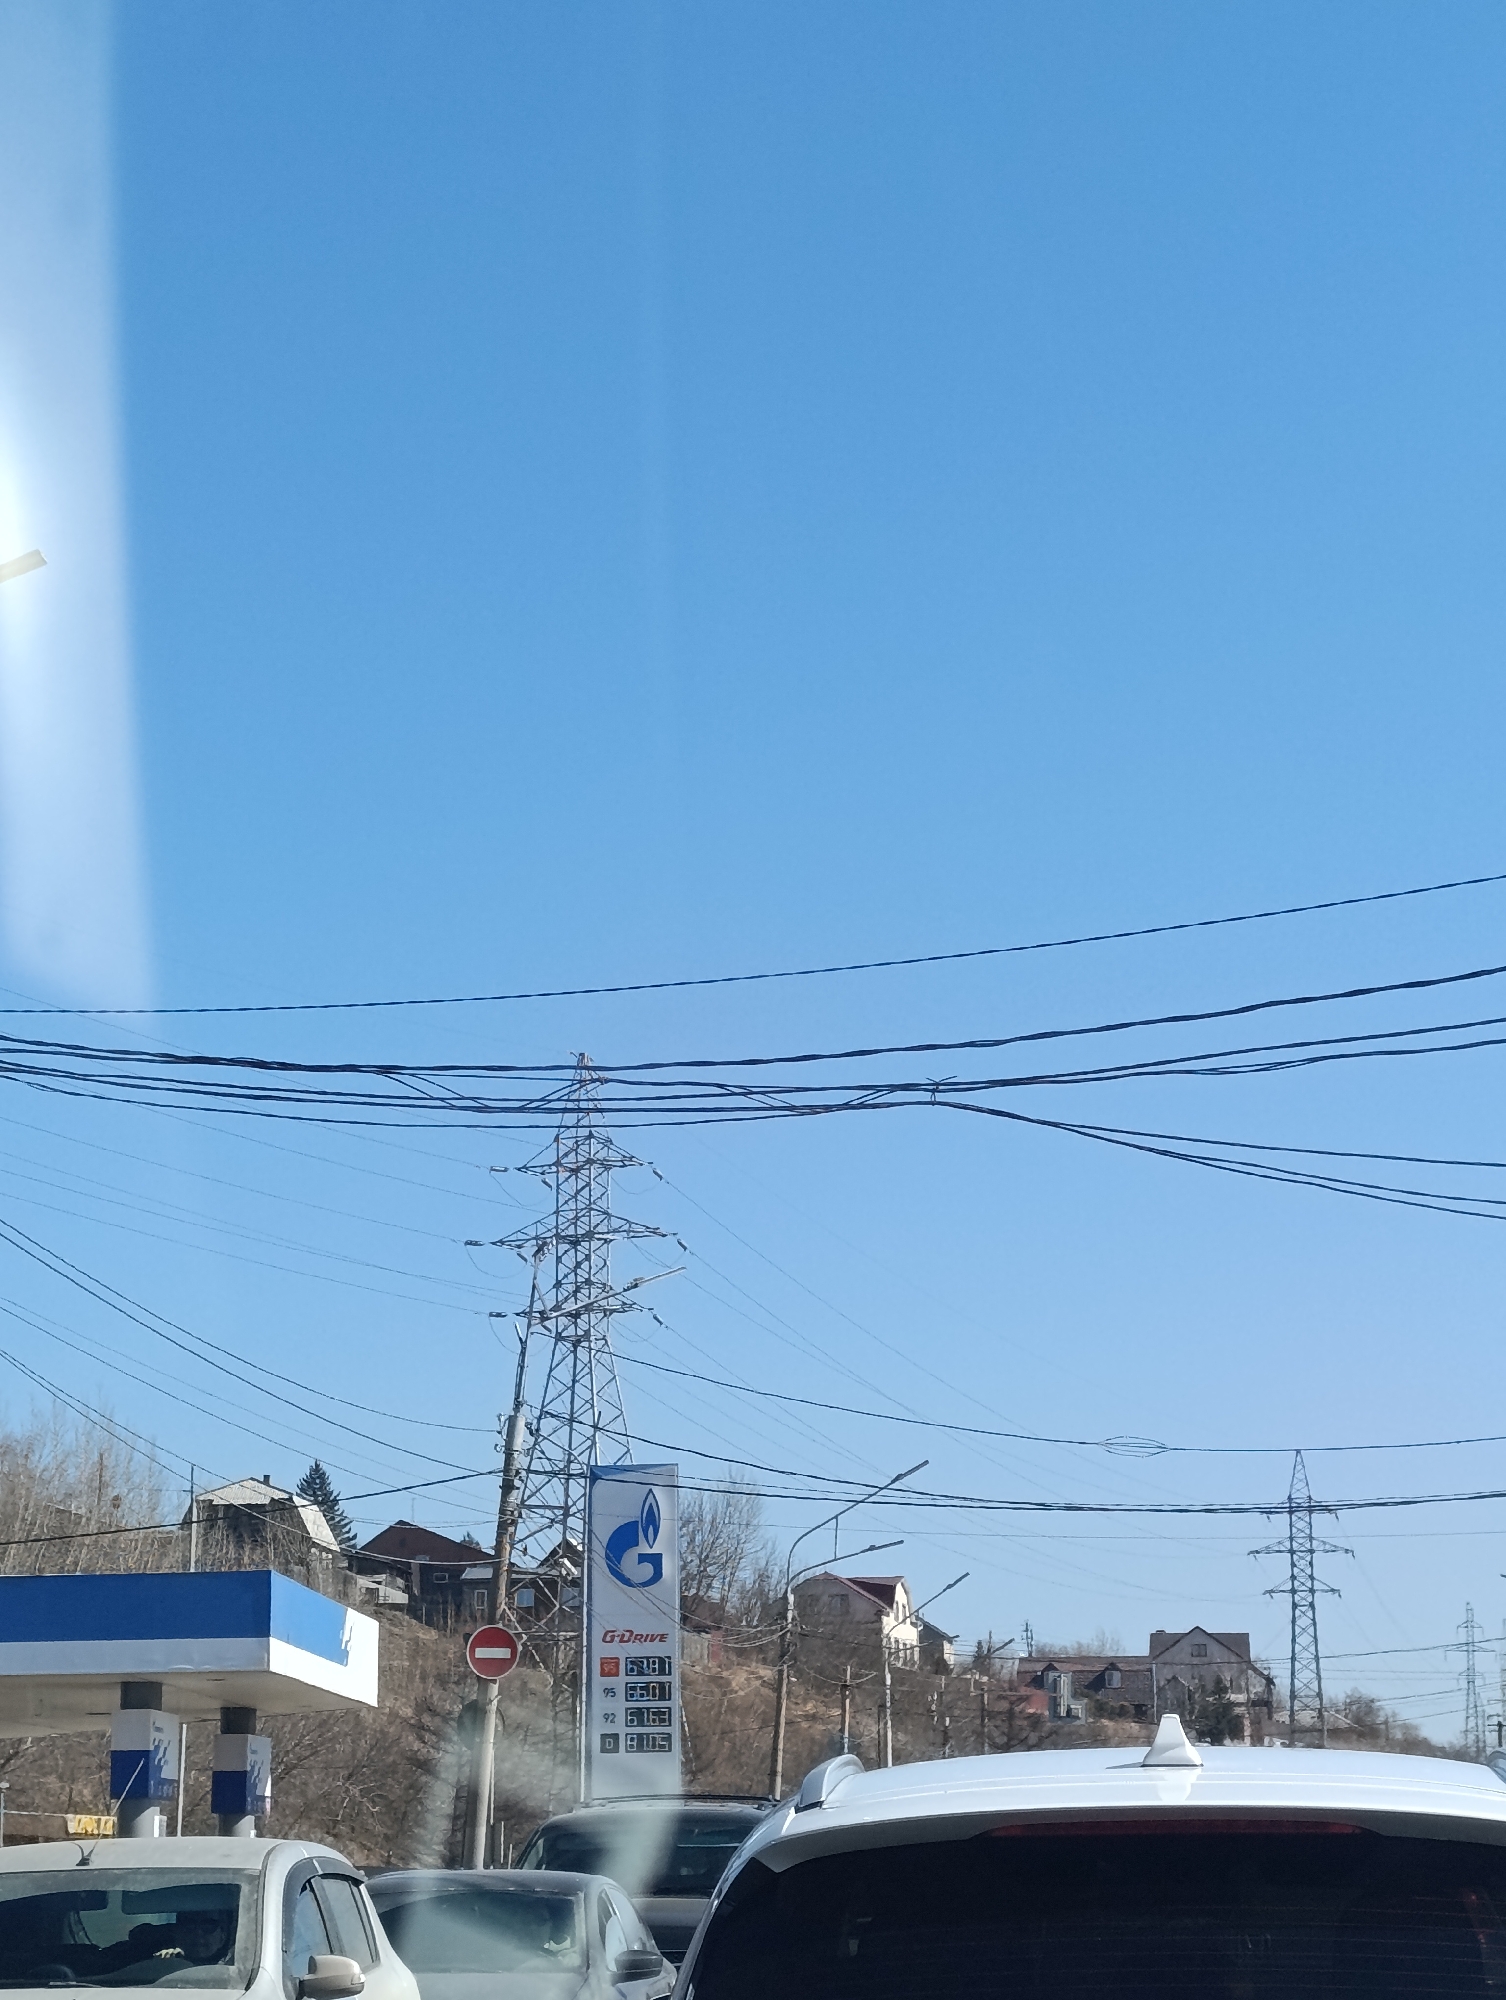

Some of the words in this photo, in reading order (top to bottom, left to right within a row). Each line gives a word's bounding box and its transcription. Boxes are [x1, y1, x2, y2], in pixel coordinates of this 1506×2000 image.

[602, 1687, 617, 1698] 95
[602, 1712, 617, 1724] 92
[605, 1738, 614, 1749] D
